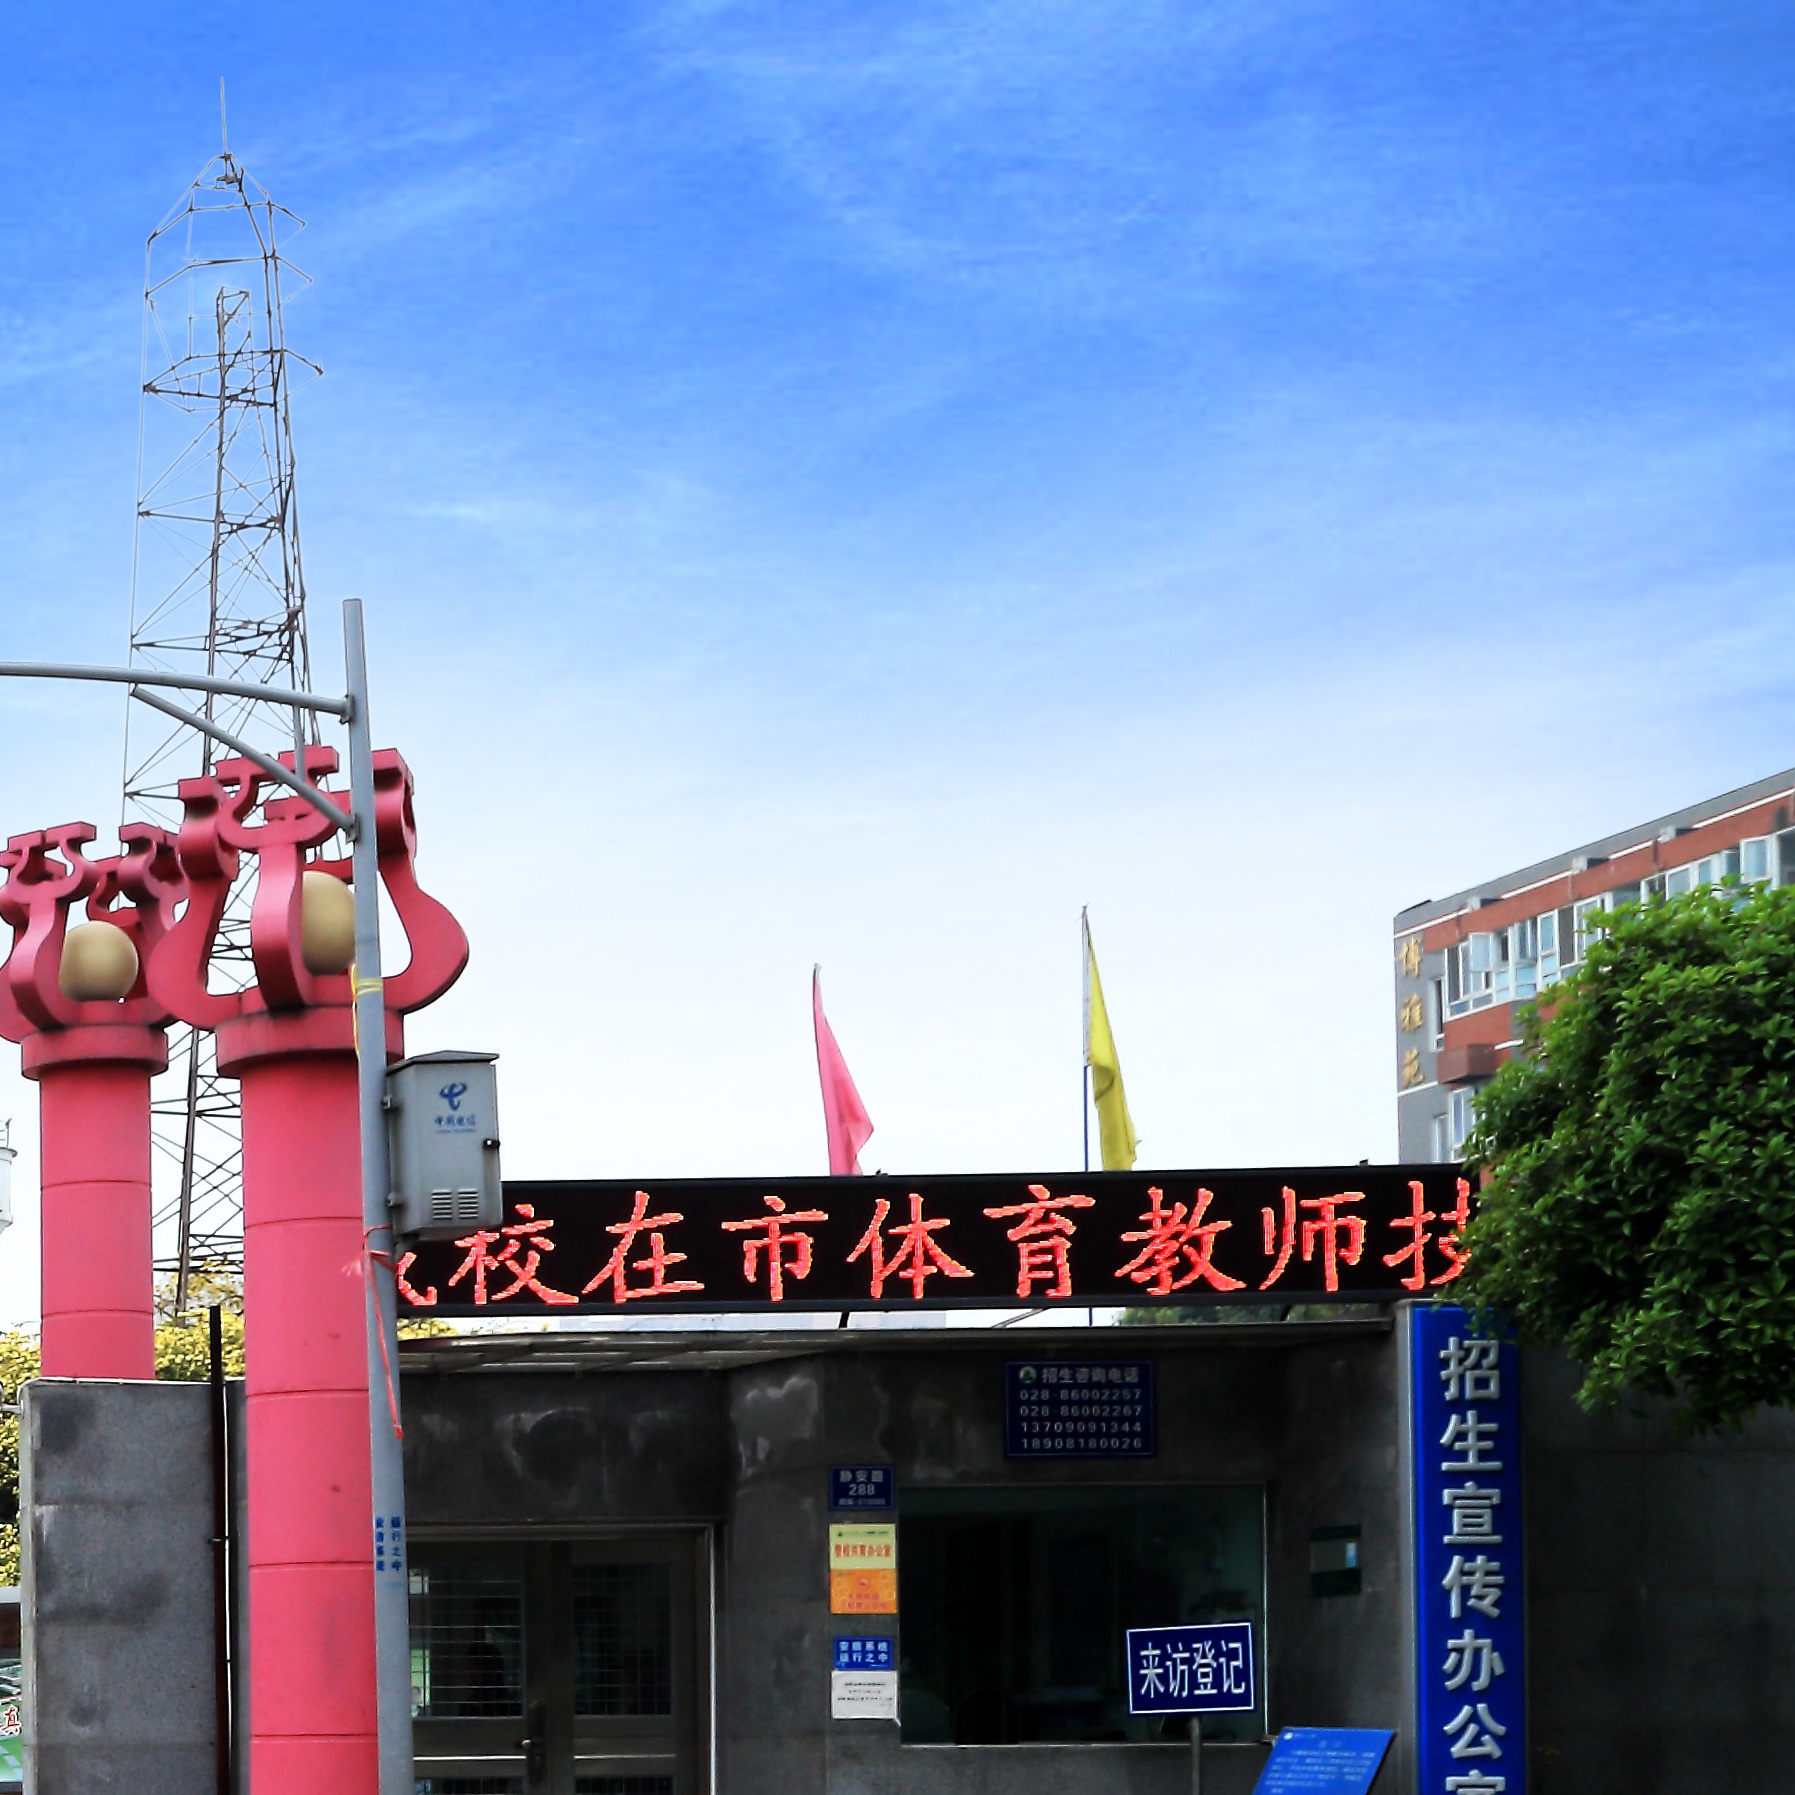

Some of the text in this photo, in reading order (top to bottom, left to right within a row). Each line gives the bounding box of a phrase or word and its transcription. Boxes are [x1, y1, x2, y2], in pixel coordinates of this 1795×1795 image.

[396, 1176, 1473, 1307] 校在市体育教师技
[1042, 1366, 1140, 1383] 招生咨询电话
[1019, 1388, 1142, 1401] 028-86002257
[1019, 1404, 1142, 1417] 028-86002267
[1020, 1421, 1142, 1433] 13709091344
[1020, 1437, 1142, 1449] 18908180026
[849, 1484, 876, 1497] 288
[1139, 1640, 1246, 1698] 来访登记
